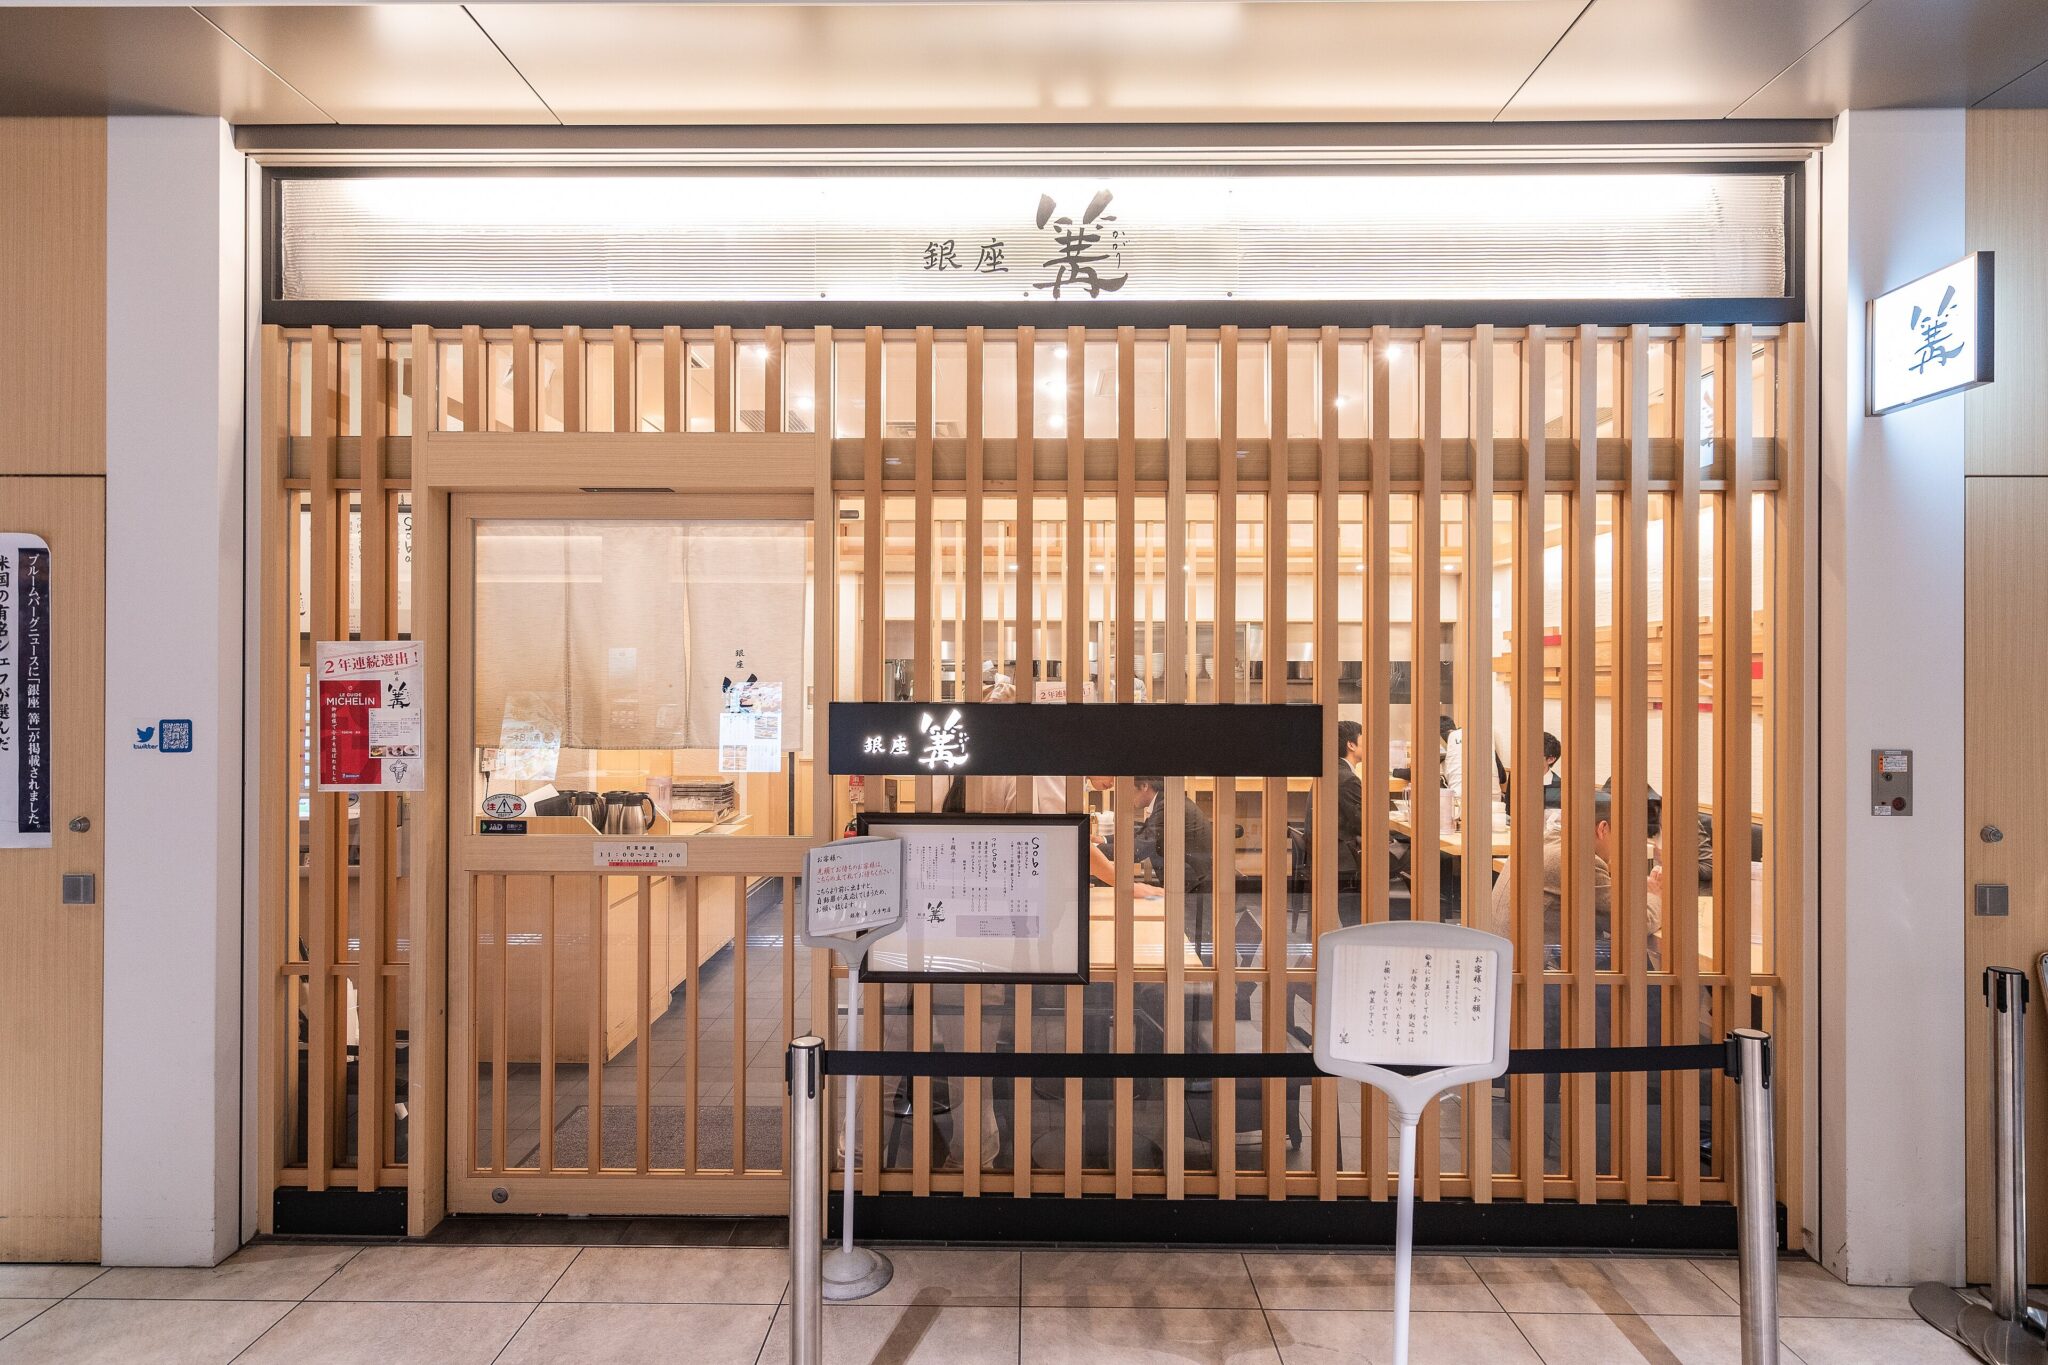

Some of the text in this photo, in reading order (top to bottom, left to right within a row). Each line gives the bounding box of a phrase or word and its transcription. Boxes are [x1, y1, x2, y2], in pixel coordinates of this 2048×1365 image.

[923, 188, 1129, 300] 銀座 篝
[1908, 285, 1965, 375] 篝
[735, 648, 745, 669] 銀座
[326, 697, 375, 706] MICHELIN
[863, 708, 969, 769] 銀座 篝
[486, 802, 522, 811] 注 意
[817, 853, 843, 863] お客様へ
[1031, 836, 1040, 876] Soba
[1471, 955, 1483, 1022] お客様へお願い
